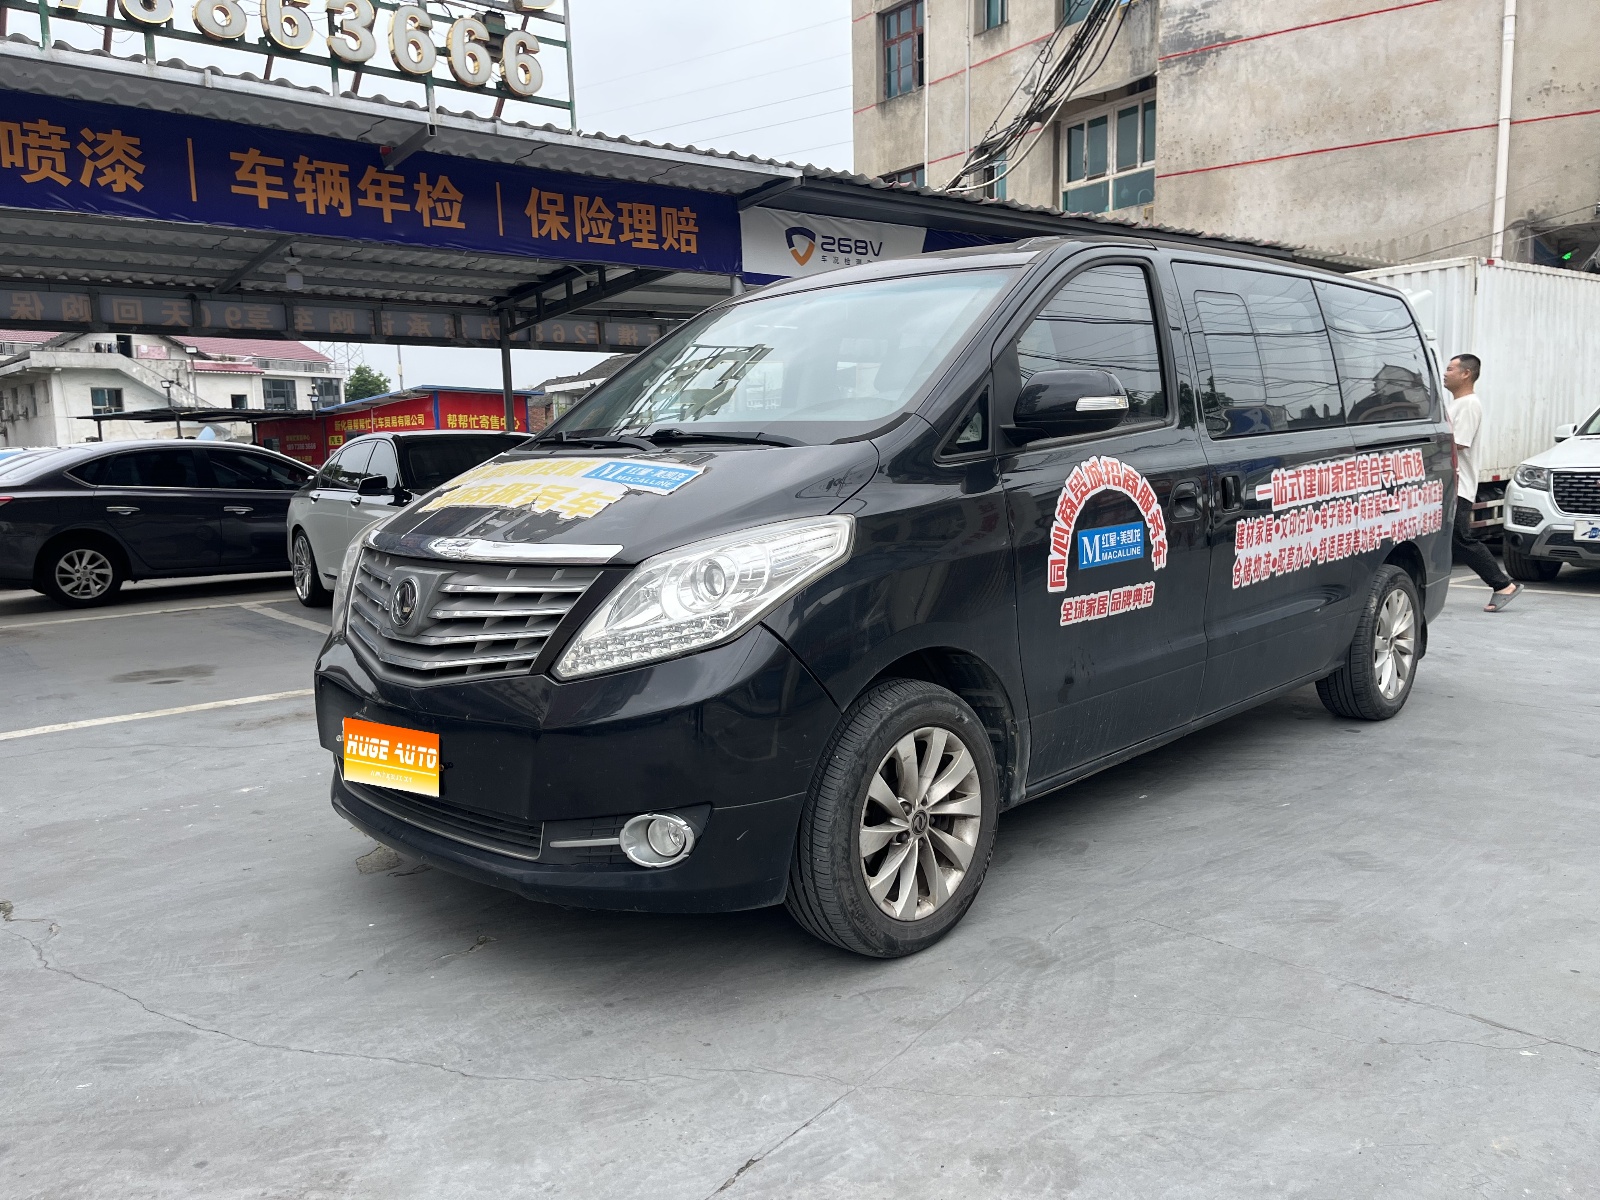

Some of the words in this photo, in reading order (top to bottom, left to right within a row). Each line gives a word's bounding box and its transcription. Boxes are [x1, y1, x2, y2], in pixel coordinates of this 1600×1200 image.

[0, 118, 146, 193] 喷漆
[229, 147, 467, 229] 车辆年检
[524, 186, 700, 255] 保险理赔
[820, 234, 883, 257] 268V
[615, 475, 675, 488] MACALLINE
[1256, 450, 1425, 507] 一站式建材家居综合专业市场
[1048, 459, 1168, 589] 同心商贸城招商服务车
[1081, 534, 1102, 566] M
[1101, 548, 1142, 562] MACALLINE
[1061, 594, 1109, 623] 全球家居
[1110, 584, 1155, 612] 品牌典范
